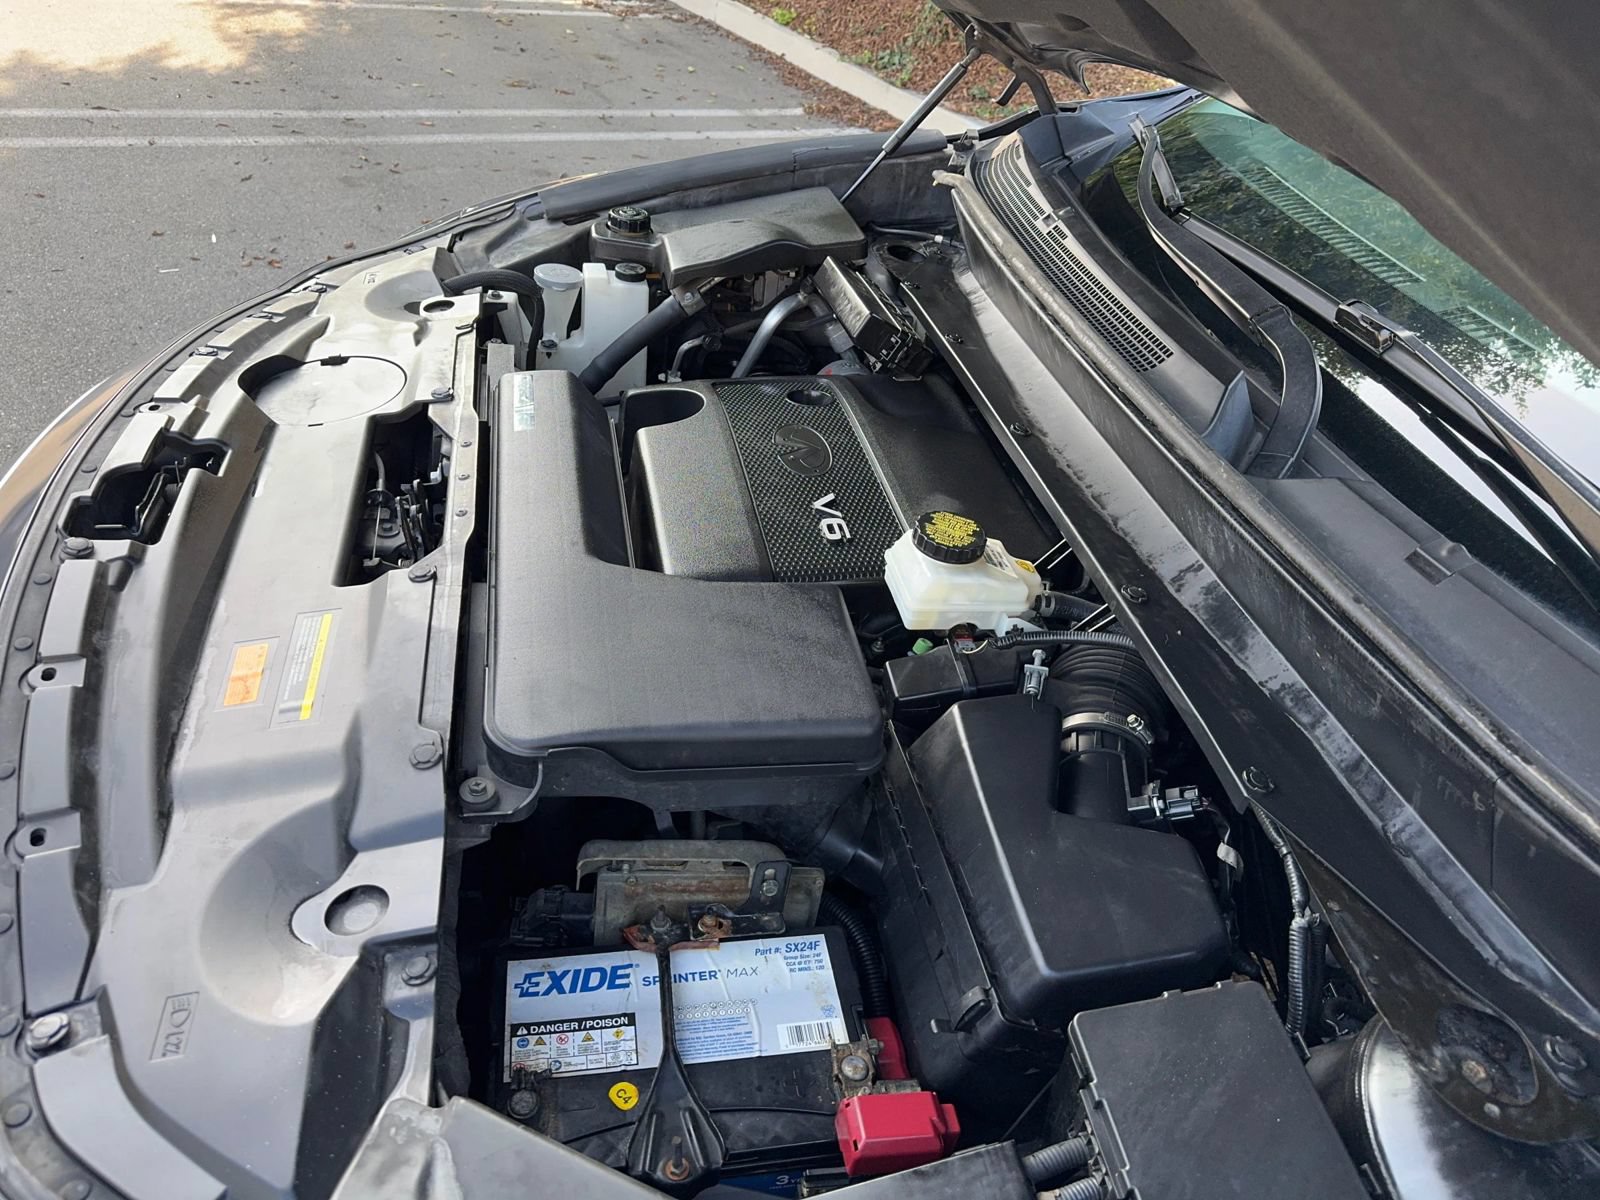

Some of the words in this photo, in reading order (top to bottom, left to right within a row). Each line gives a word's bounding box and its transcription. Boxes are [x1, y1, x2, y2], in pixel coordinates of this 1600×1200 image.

[812, 492, 851, 540] V6
[755, 947, 772, 956] Part
[785, 940, 820, 953] SX24F
[514, 963, 634, 998] EXIDE
[642, 969, 719, 987] SPINTER
[726, 966, 759, 979] MAX
[530, 1022, 579, 1034] DANGER
[616, 1088, 632, 1104] C4
[775, 1175, 790, 1185] 3
